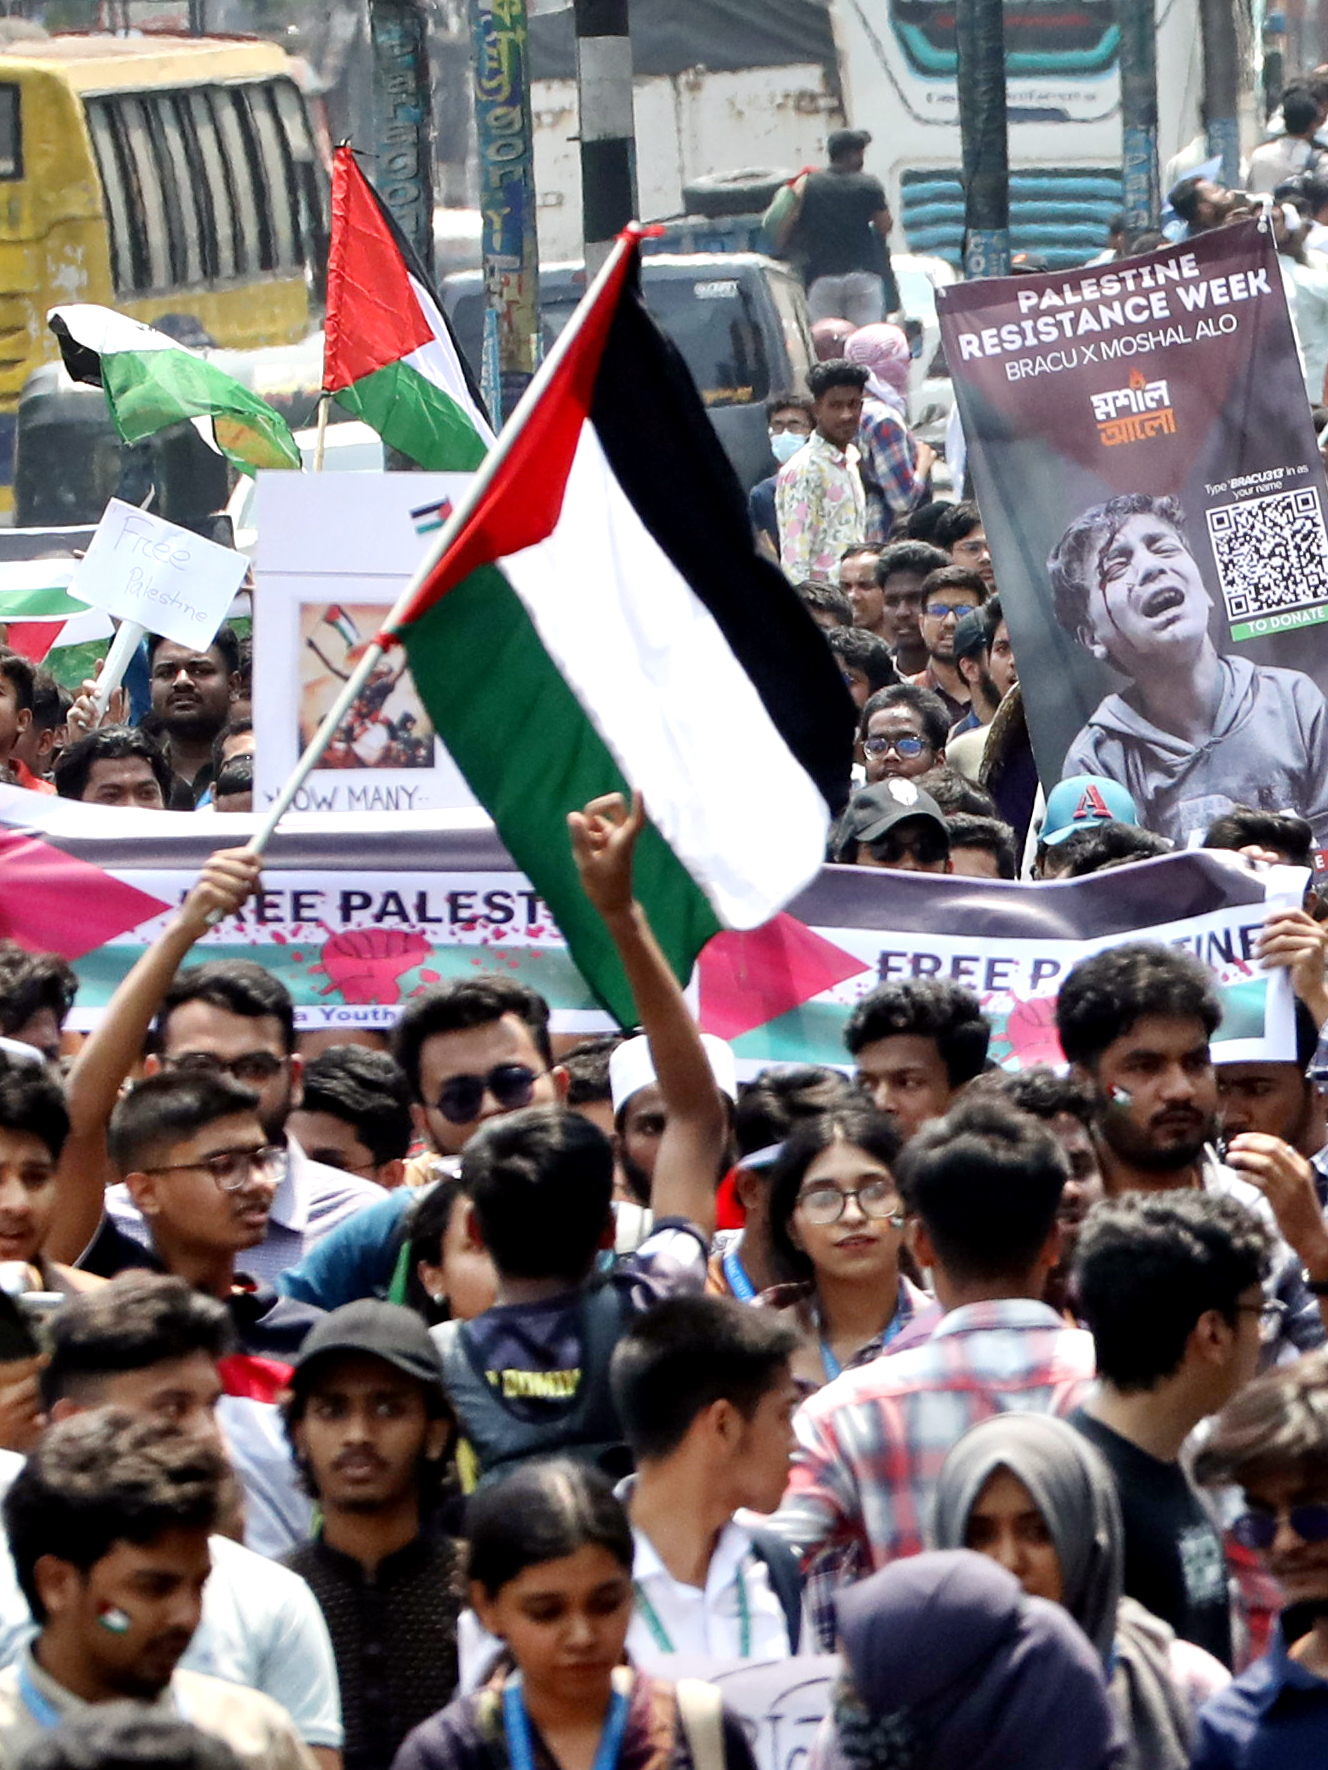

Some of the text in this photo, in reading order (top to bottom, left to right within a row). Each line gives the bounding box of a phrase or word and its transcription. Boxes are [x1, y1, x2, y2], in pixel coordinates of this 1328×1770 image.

[1016, 253, 1200, 314] PALESTINE
[957, 268, 1273, 361] RESISTANCE WEEK
[1004, 313, 1238, 382] BRACU X MOSHAL ALO
[1090, 378, 1172, 420] মশাল
[1096, 407, 1178, 447] আলো
[1204, 482, 1228, 497] Type
[1286, 465, 1296, 476] in
[1296, 464, 1309, 475] as
[1232, 480, 1283, 501] your name
[114, 515, 190, 571] Free
[124, 566, 208, 623] Palestine
[1246, 606, 1326, 634] TO DONATE
[1073, 784, 1113, 819] A
[340, 889, 542, 924] PALEST
[877, 950, 1015, 992] FREE
[321, 1006, 397, 1024] Youth
